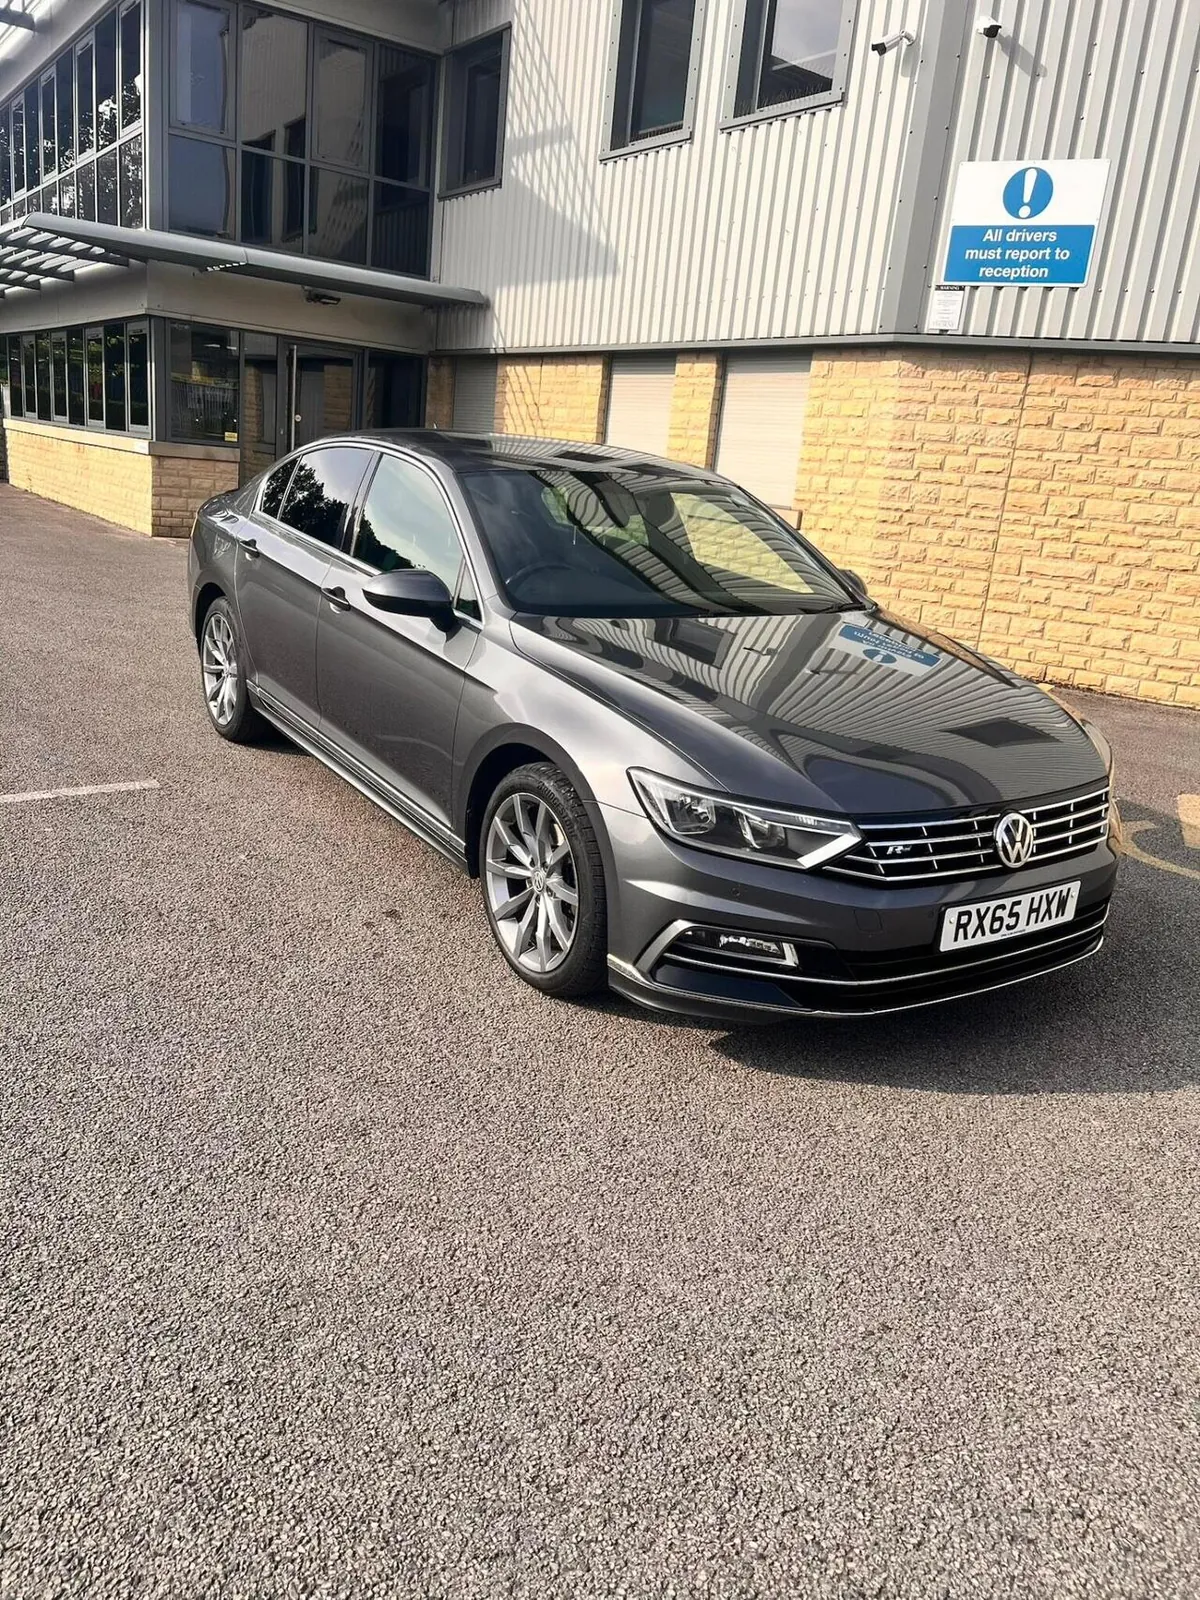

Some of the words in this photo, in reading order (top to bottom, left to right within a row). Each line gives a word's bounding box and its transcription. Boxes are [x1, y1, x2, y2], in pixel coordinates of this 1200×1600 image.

[982, 229, 1003, 242] All
[1006, 229, 1057, 242] drivers
[965, 247, 1002, 260] must
[1005, 247, 1051, 263] report
[1055, 247, 1070, 260] to
[979, 264, 1049, 280] reception
[953, 899, 1022, 943] RX65
[1025, 887, 1071, 927] HXW
